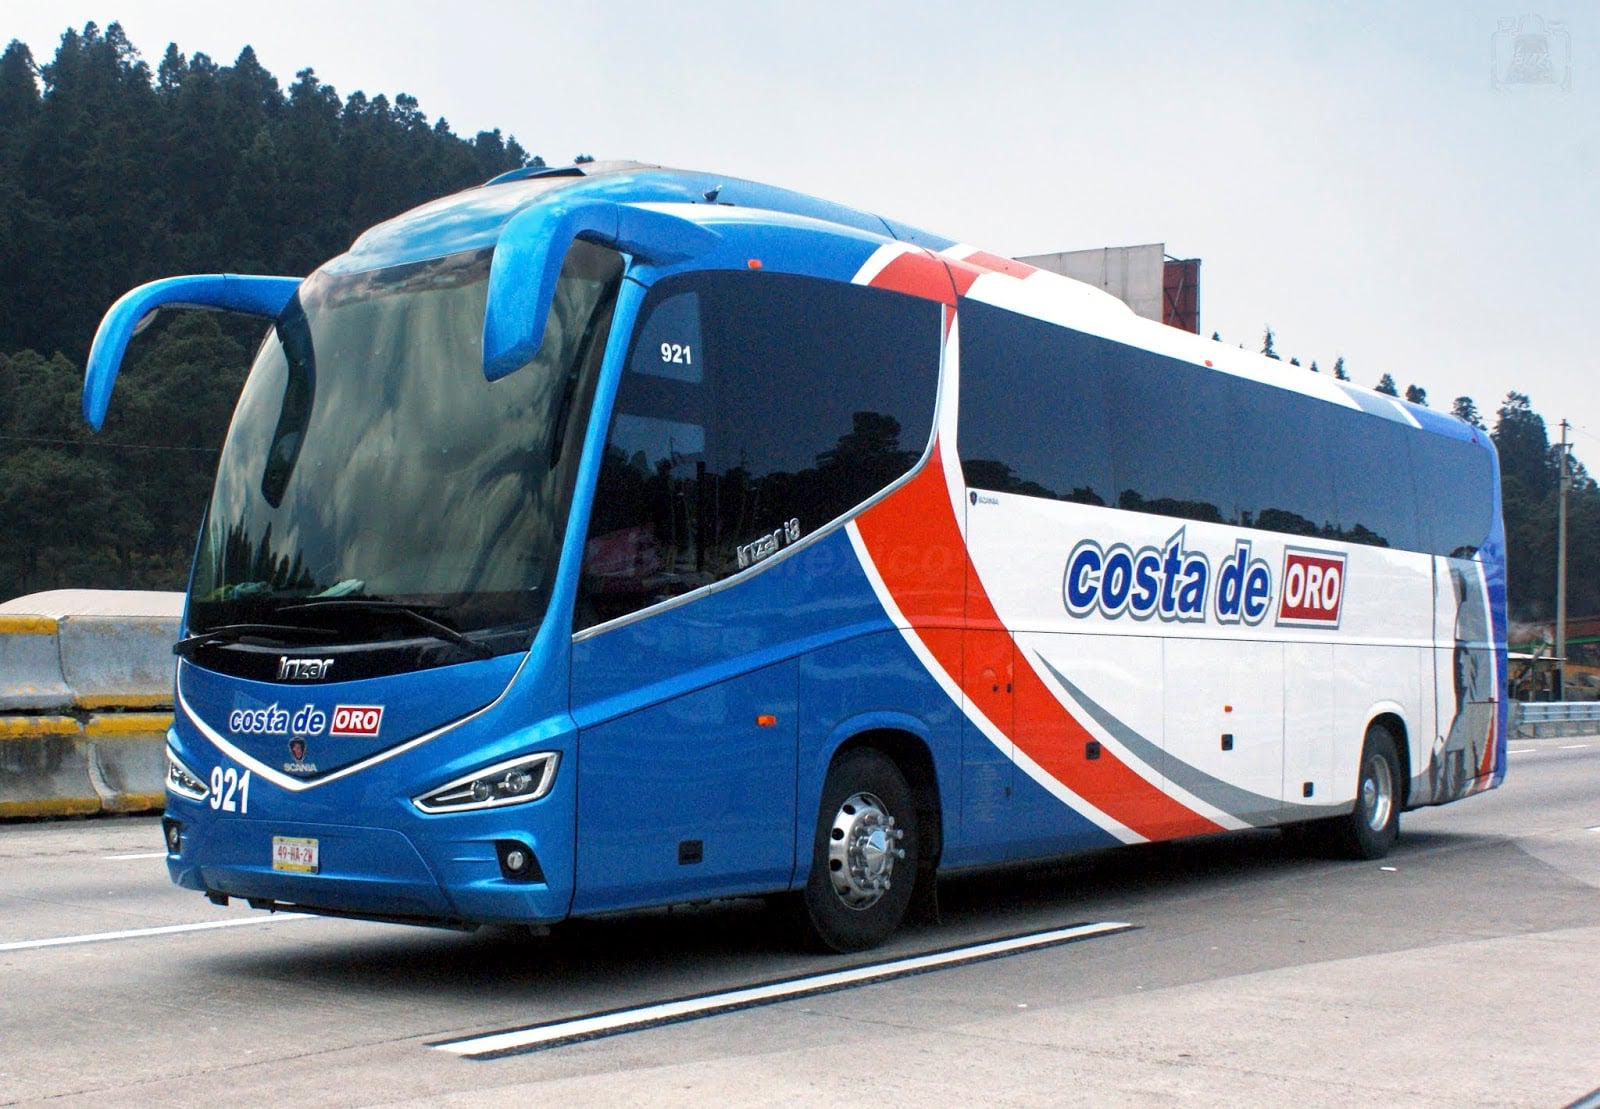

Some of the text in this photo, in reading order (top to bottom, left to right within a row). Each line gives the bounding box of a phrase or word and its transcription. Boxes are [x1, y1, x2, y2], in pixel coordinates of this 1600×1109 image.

[661, 342, 692, 365] 921
[784, 517, 801, 545] i8
[1065, 536, 1343, 620] costa de ORO
[277, 656, 335, 680] Irizar
[230, 703, 380, 734] costa de ORO
[283, 762, 318, 773] SCANIA
[210, 766, 251, 814] 921
